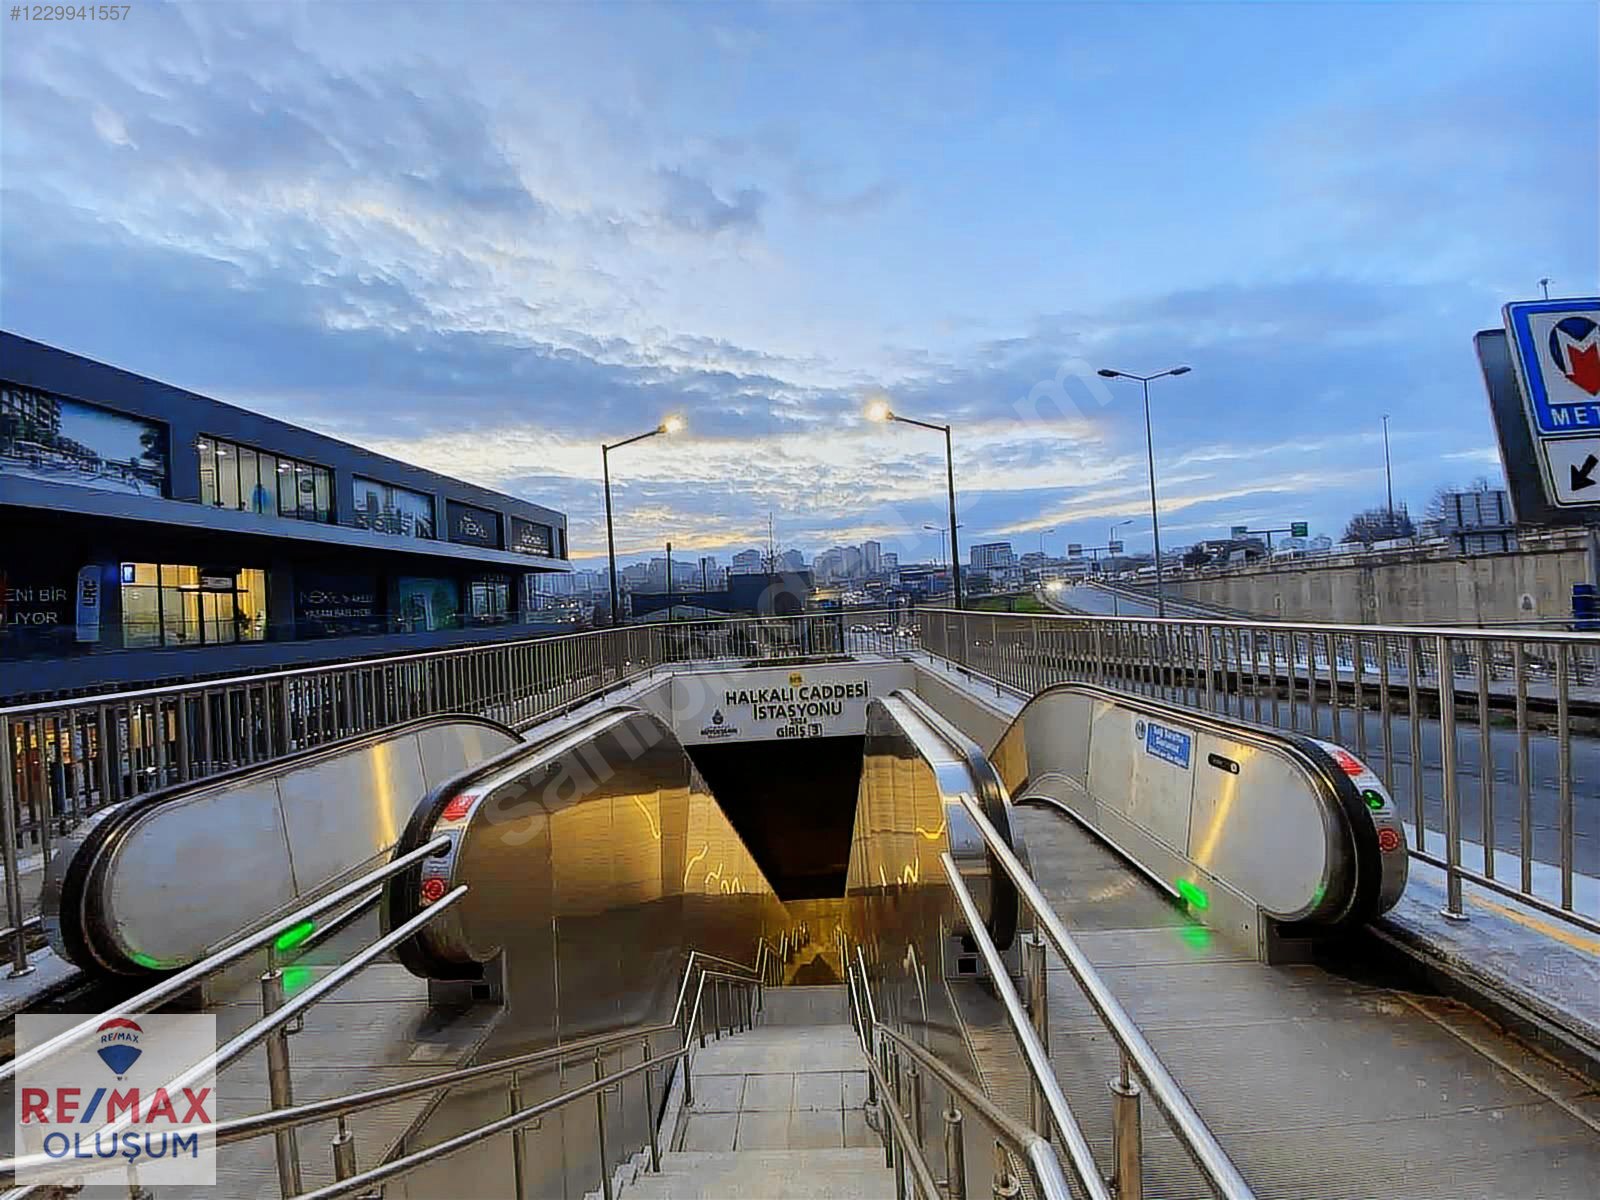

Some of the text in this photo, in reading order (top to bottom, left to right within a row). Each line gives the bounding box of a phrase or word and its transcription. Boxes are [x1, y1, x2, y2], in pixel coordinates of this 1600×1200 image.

[725, 680, 868, 705] HALKALI CADDESİ
[753, 701, 843, 720] İSTASYONU
[776, 724, 806, 738] GİRİŞ
